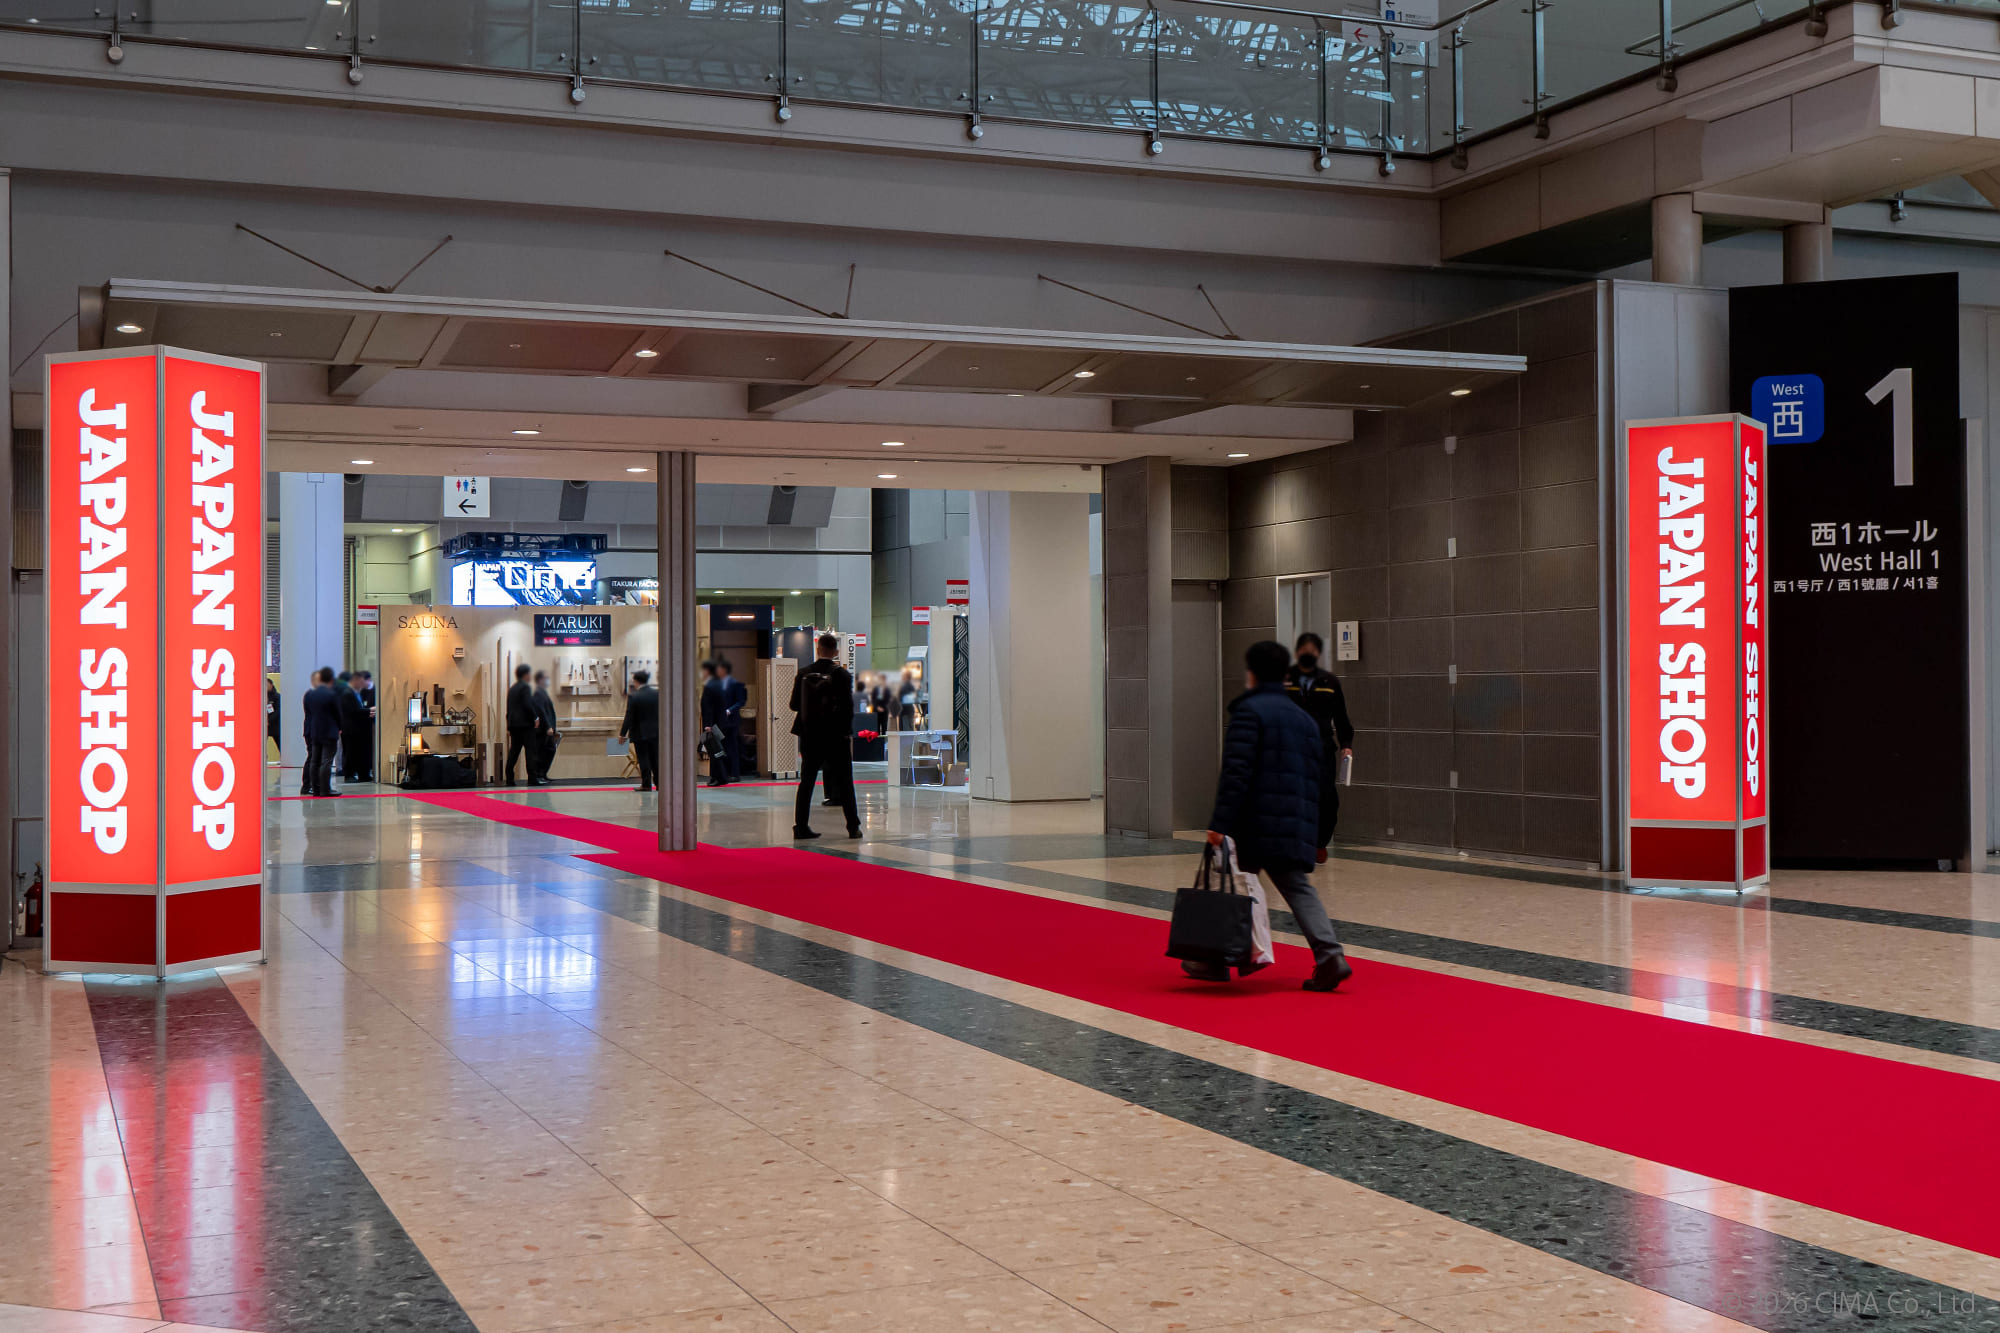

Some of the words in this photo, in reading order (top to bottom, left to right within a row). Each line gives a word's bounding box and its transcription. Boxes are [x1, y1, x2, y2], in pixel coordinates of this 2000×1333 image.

[1771, 383, 1804, 396] West
[1772, 401, 1804, 437] 西
[1864, 367, 1914, 486] 1
[79, 388, 127, 629] JAPAN
[191, 390, 235, 631] JAPAN
[1657, 447, 1705, 629] JAPAN
[1744, 445, 1758, 629] JAPAN
[1811, 520, 1938, 547] 西1ホール
[1819, 552, 1872, 572] West
[1880, 549, 1921, 571] Hall
[1931, 550, 1939, 569] 1
[398, 615, 458, 628] SAUNA
[543, 616, 602, 628] MARUKI
[1773, 580, 1824, 593] 西1号厅
[1827, 579, 1834, 591] /
[1892, 577, 1899, 590] /
[1903, 576, 1939, 590] 서1홀
[80, 647, 128, 854] SHOP
[192, 648, 235, 851] SHOP
[1659, 642, 1707, 799] SHOP
[1745, 641, 1759, 797] SHOP
